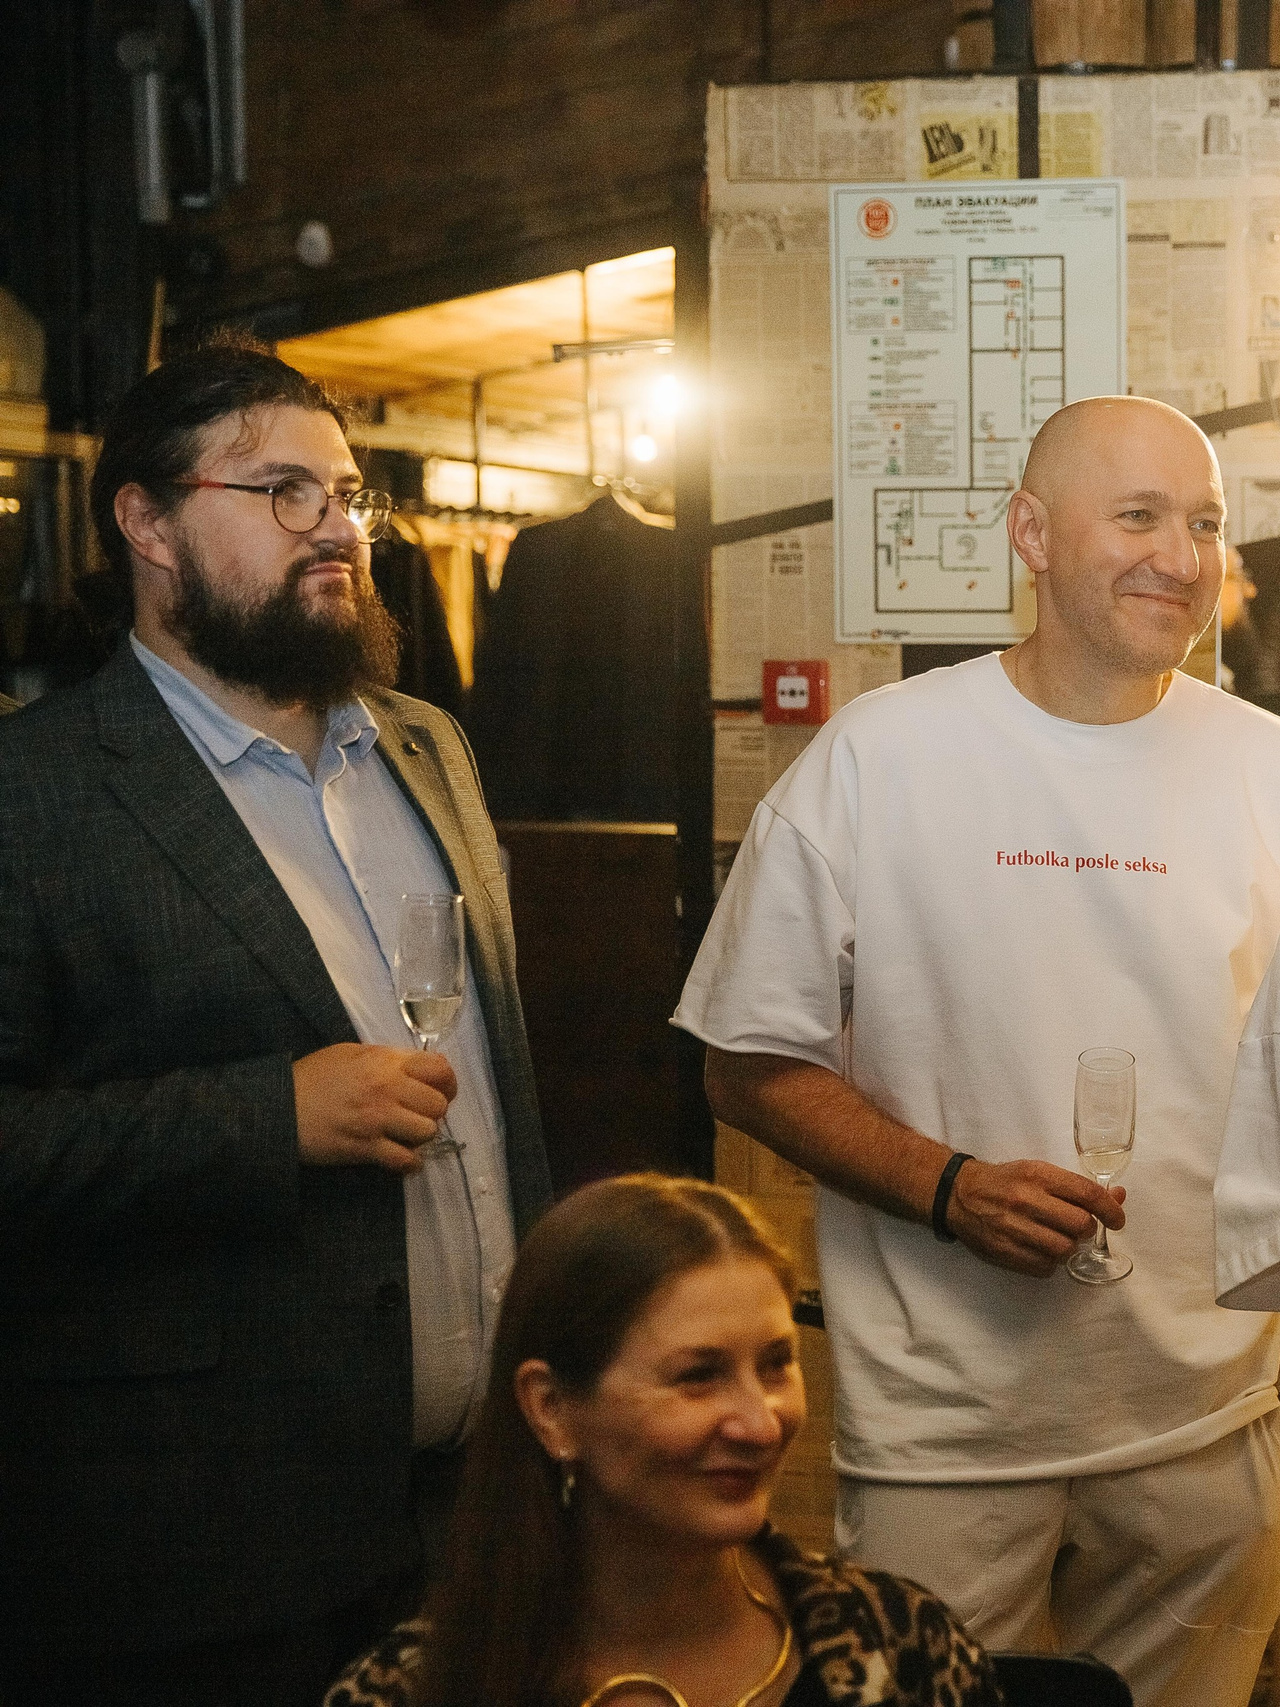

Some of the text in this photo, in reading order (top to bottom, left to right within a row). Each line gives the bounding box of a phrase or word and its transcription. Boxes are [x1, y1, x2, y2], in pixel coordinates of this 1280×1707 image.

[996, 849, 1168, 875] Futbolka posle seksa
